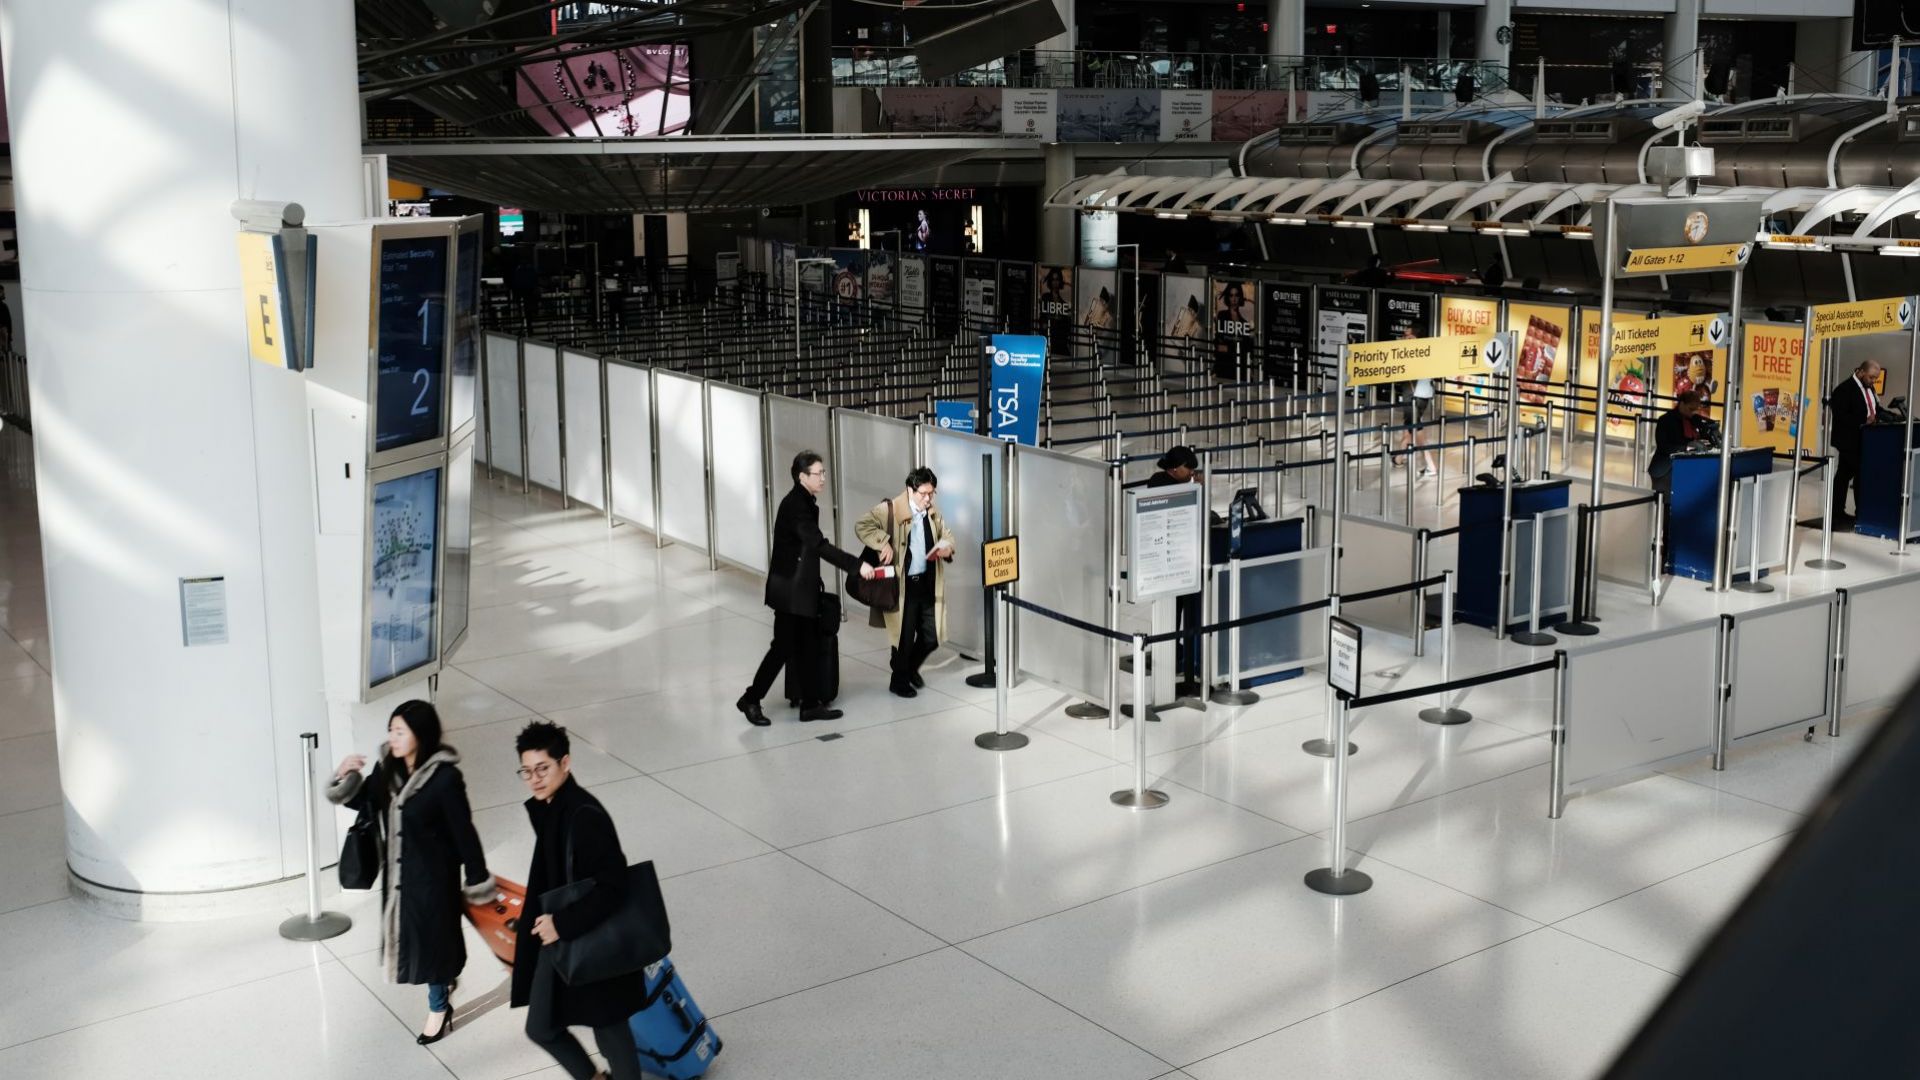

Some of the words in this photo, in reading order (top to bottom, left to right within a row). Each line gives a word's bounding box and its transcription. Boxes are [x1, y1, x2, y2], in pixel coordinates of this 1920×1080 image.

[857, 190, 928, 202] VICTORIA'S
[931, 188, 975, 201] SECRET
[1630, 256, 1643, 266] All
[1644, 255, 1666, 265] Gates
[1668, 253, 1685, 264] 1-12
[841, 281, 851, 296] #1
[1041, 300, 1069, 316] LIBRE
[1395, 300, 1408, 310] DUTY
[1409, 301, 1420, 311] FREE
[417, 298, 430, 346] 1
[1447, 307, 1465, 322] BUY
[1466, 309, 1473, 322] 3
[1474, 310, 1492, 326] GET
[1816, 310, 1836, 322] Special
[1836, 309, 1864, 320] Assistance
[1217, 319, 1250, 336] LIBRE
[1447, 324, 1452, 336] 1
[1454, 324, 1477, 336] FREE
[1615, 330, 1626, 340] All
[1627, 326, 1660, 340] Ticketed
[1815, 323, 1831, 336] Flight
[1831, 322, 1846, 332] Crew
[1846, 321, 1851, 330] &
[1852, 319, 1880, 332] Employees
[1614, 342, 1657, 355] Passengers
[1753, 335, 1777, 353] BUY
[1779, 338, 1787, 354] 3
[1790, 339, 1804, 356] GE
[1353, 350, 1389, 363] Priority
[1391, 345, 1431, 360] Ticketed
[1353, 364, 1406, 378] Passengers
[1752, 354, 1758, 370] 1
[1762, 355, 1792, 374] FREE
[410, 368, 430, 416] 2
[997, 383, 1018, 428] TSA
[991, 546, 1004, 556] First
[1005, 545, 1010, 553] &
[988, 557, 1014, 568] Business
[993, 568, 1009, 577] Class
